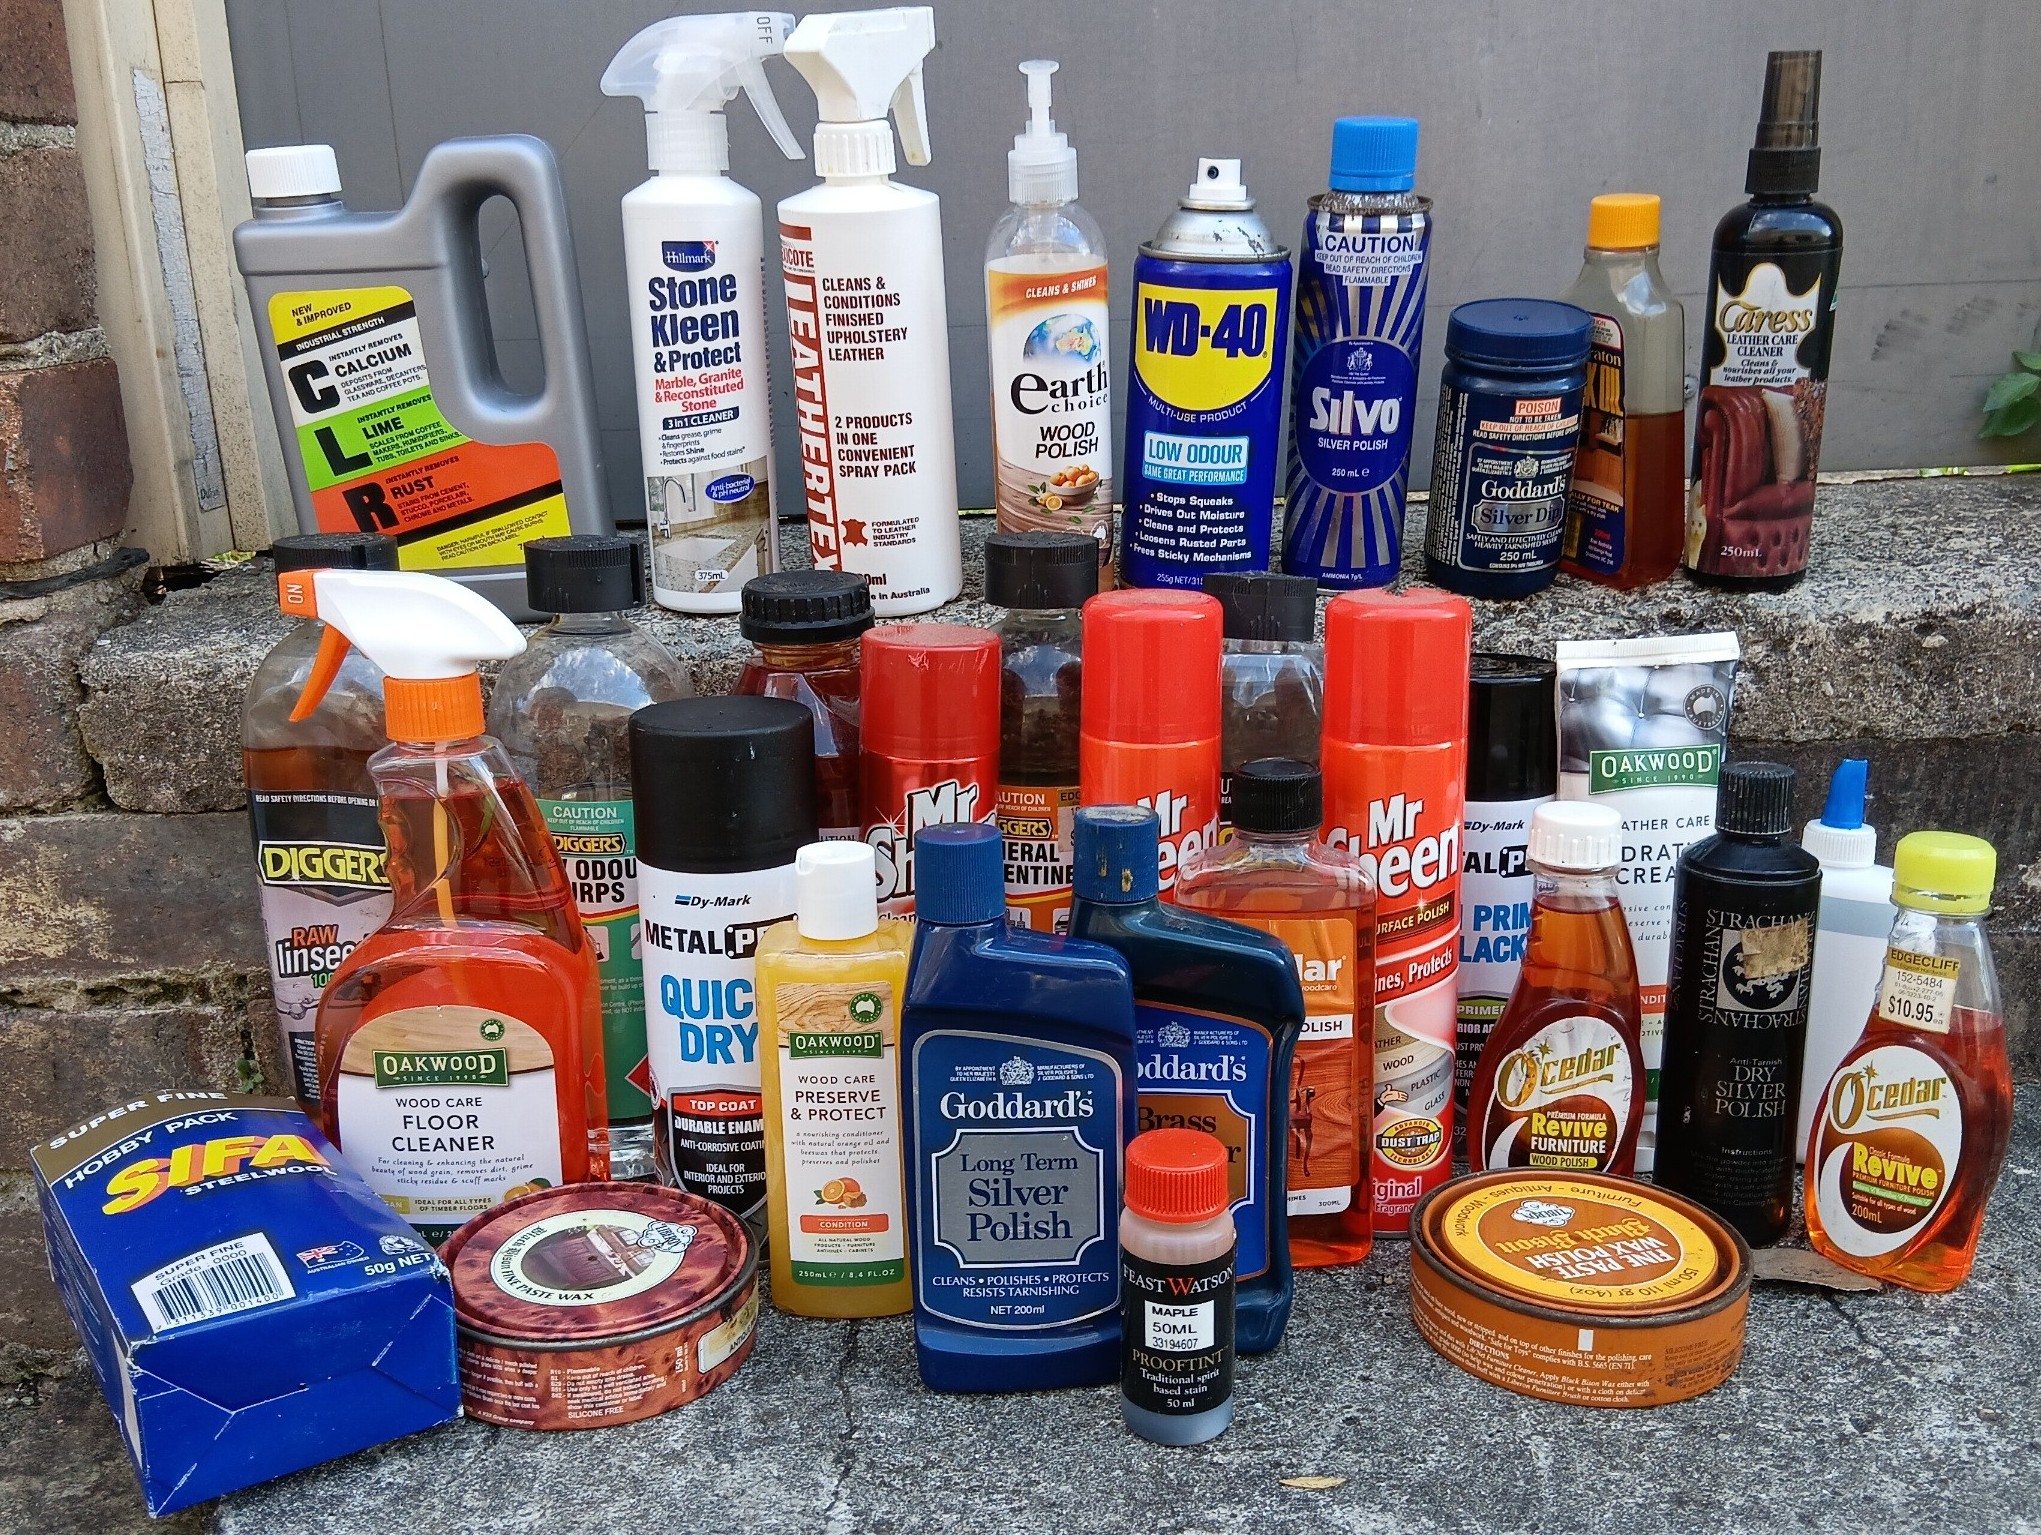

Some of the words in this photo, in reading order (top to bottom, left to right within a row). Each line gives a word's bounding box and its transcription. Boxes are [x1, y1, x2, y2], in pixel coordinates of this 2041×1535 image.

[756, 16, 772, 44] OFF
[1325, 235, 1414, 253] CAUTION
[666, 252, 712, 264] Hillmark
[1325, 264, 1340, 273] READ
[1343, 265, 1369, 273] SAFETY
[1371, 265, 1411, 273] DIRECTIONS
[822, 277, 871, 291] CLEANS
[876, 277, 886, 290] &
[1345, 276, 1389, 284] FLAMMABLE
[649, 274, 737, 312] Stone
[824, 293, 901, 309] CONDITIONS
[291, 303, 313, 318] NEW
[825, 312, 883, 326] FINISHED
[1719, 301, 1813, 333] Caress
[651, 310, 739, 348] Kleen
[827, 327, 908, 344] UPHOLSTERY
[1145, 297, 1267, 358] WD-40
[1727, 334, 1770, 345] LEATHER
[1772, 334, 1798, 345] CARE
[654, 352, 666, 373] &
[668, 342, 741, 372] Protect
[829, 347, 884, 361] LEATHER
[1737, 346, 1783, 357] CLEANER
[334, 343, 412, 378] CALCIUM
[288, 359, 341, 414] C
[1011, 362, 1108, 415] earth
[682, 398, 717, 412] Stone
[1052, 393, 1108, 413] choice
[1148, 396, 1196, 423] MULTI-USE
[1200, 401, 1247, 423] PRODUCT
[1310, 387, 1400, 436] Silvo
[1518, 400, 1559, 414] POISON
[690, 410, 734, 426] CLEANER
[835, 416, 842, 428] 2
[846, 412, 912, 429] PRODUCTS
[361, 417, 405, 441] LIME
[1040, 421, 1095, 442] WOOD
[837, 433, 848, 445] IN
[853, 433, 877, 445] ONE
[1318, 437, 1350, 450] SILVER
[1353, 439, 1388, 451] POLISH
[314, 426, 373, 477] L
[838, 445, 915, 462] CONVENIENT
[1035, 437, 1098, 459] POLISH
[1149, 439, 1183, 462] LOW
[1187, 444, 1242, 464] ODOUR
[840, 465, 879, 477] SPRAY
[884, 461, 916, 476] PACK
[1144, 464, 1161, 477] SAME
[1163, 468, 1186, 481] GREAT
[1189, 469, 1244, 482] PERFORMANCE
[390, 475, 434, 500] RUST
[1481, 474, 1565, 498] Goddard's
[1156, 493, 1186, 505] Stops
[1190, 495, 1233, 508] Squeaks
[1144, 504, 1173, 517] Drives
[1176, 509, 1196, 520] Out
[1200, 511, 1245, 520] Moisture
[1480, 507, 1532, 525] Silver
[1535, 503, 1560, 522] Dip
[872, 517, 920, 527] FORMULATED
[1144, 518, 1174, 532] Cleans
[1177, 525, 1196, 534] and
[1200, 525, 1244, 534] Protects
[874, 537, 916, 547] STANDARDS
[698, 572, 725, 580] 375mL
[287, 583, 304, 604] ON
[1601, 750, 1712, 778] OAKWOOD
[553, 806, 617, 819] CAUTION
[1368, 793, 1424, 849] Mr
[554, 835, 620, 852] DIGGERS
[690, 895, 752, 909] Dy-Mark
[1417, 901, 1450, 923] POLISH
[293, 926, 337, 946] RAW
[1891, 949, 1959, 971] EDGECLIFF
[1897, 971, 1942, 988] 152-5484
[1888, 995, 1934, 1022] $10.95
[680, 1021, 758, 1065] DRY
[795, 1034, 875, 1050] OAKWOOD
[383, 1054, 496, 1075] OAKWOOD
[1383, 1054, 1414, 1071] WOOD
[1730, 1057, 1783, 1066] Anti-Tarnish
[798, 1075, 838, 1084] WOOD
[844, 1075, 876, 1084] CARE
[1410, 1069, 1441, 1092] PLASTIC
[1734, 1066, 1776, 1082] DRY
[795, 1090, 881, 1104] PRESERVE
[1715, 1081, 1786, 1100] SILVER
[396, 1098, 441, 1108] WOOD
[446, 1097, 482, 1107] CARE
[690, 1100, 715, 1111] TOP
[718, 1100, 756, 1111] COAT
[940, 1090, 1094, 1120] Goddard's
[1424, 1091, 1445, 1112] GLASS
[1715, 1099, 1786, 1118] POLISH
[50, 1100, 149, 1150] SUPER
[156, 1091, 229, 1104] FINE
[403, 1115, 479, 1130] FLOOR
[790, 1108, 802, 1121] &
[808, 1107, 886, 1121] PROTECT
[1138, 1106, 1217, 1133] Brass
[1532, 1113, 1607, 1137] Revive
[64, 1131, 155, 1189] HOBBY
[165, 1111, 238, 1134] PACK
[392, 1136, 495, 1152] CLEANER
[1531, 1137, 1606, 1154] FURNITURE
[706, 1163, 728, 1173] IDEAL
[729, 1163, 745, 1172] FOR
[960, 1153, 1015, 1175] Long
[1020, 1153, 1078, 1172] Term
[1531, 1153, 1558, 1166] WOOD
[1560, 1156, 1589, 1167] POLISH
[1853, 1142, 1938, 1189] Revive
[102, 1135, 330, 1215] SIFA
[707, 1184, 744, 1194] PROJECTS
[968, 1178, 1069, 1208] Silver
[1493, 1184, 1552, 1197] Antiques
[1570, 1187, 1642, 1207] Furniture
[966, 1211, 1073, 1242] Polish
[1615, 1237, 1668, 1256] WAX
[154, 1253, 208, 1280] SUPER
[211, 1241, 245, 1259] FINE
[1525, 1246, 1611, 1269] POLISH
[1625, 1250, 1675, 1268] FINE
[1552, 1258, 1624, 1279] PASTE
[932, 1276, 976, 1286] CLEANS
[987, 1275, 1041, 1286] POLISHES
[1052, 1272, 1109, 1284] PROTECTS
[516, 1284, 554, 1299] PASTE
[963, 1287, 1006, 1298] RESISTS
[1007, 1285, 1080, 1297] TARNISHING
[990, 1305, 1012, 1315] NET
[1014, 1305, 1044, 1315] 200ml
[1152, 1306, 1198, 1317] MAPLE
[1152, 1322, 1197, 1334] 50ML
[1152, 1336, 1199, 1350] 33194607
[1133, 1349, 1224, 1371] PROOFTINT
[1153, 1383, 1181, 1395] based
[1184, 1385, 1208, 1395] stain
[568, 1408, 602, 1419] SILICONE
[604, 1405, 624, 1416] FREE
